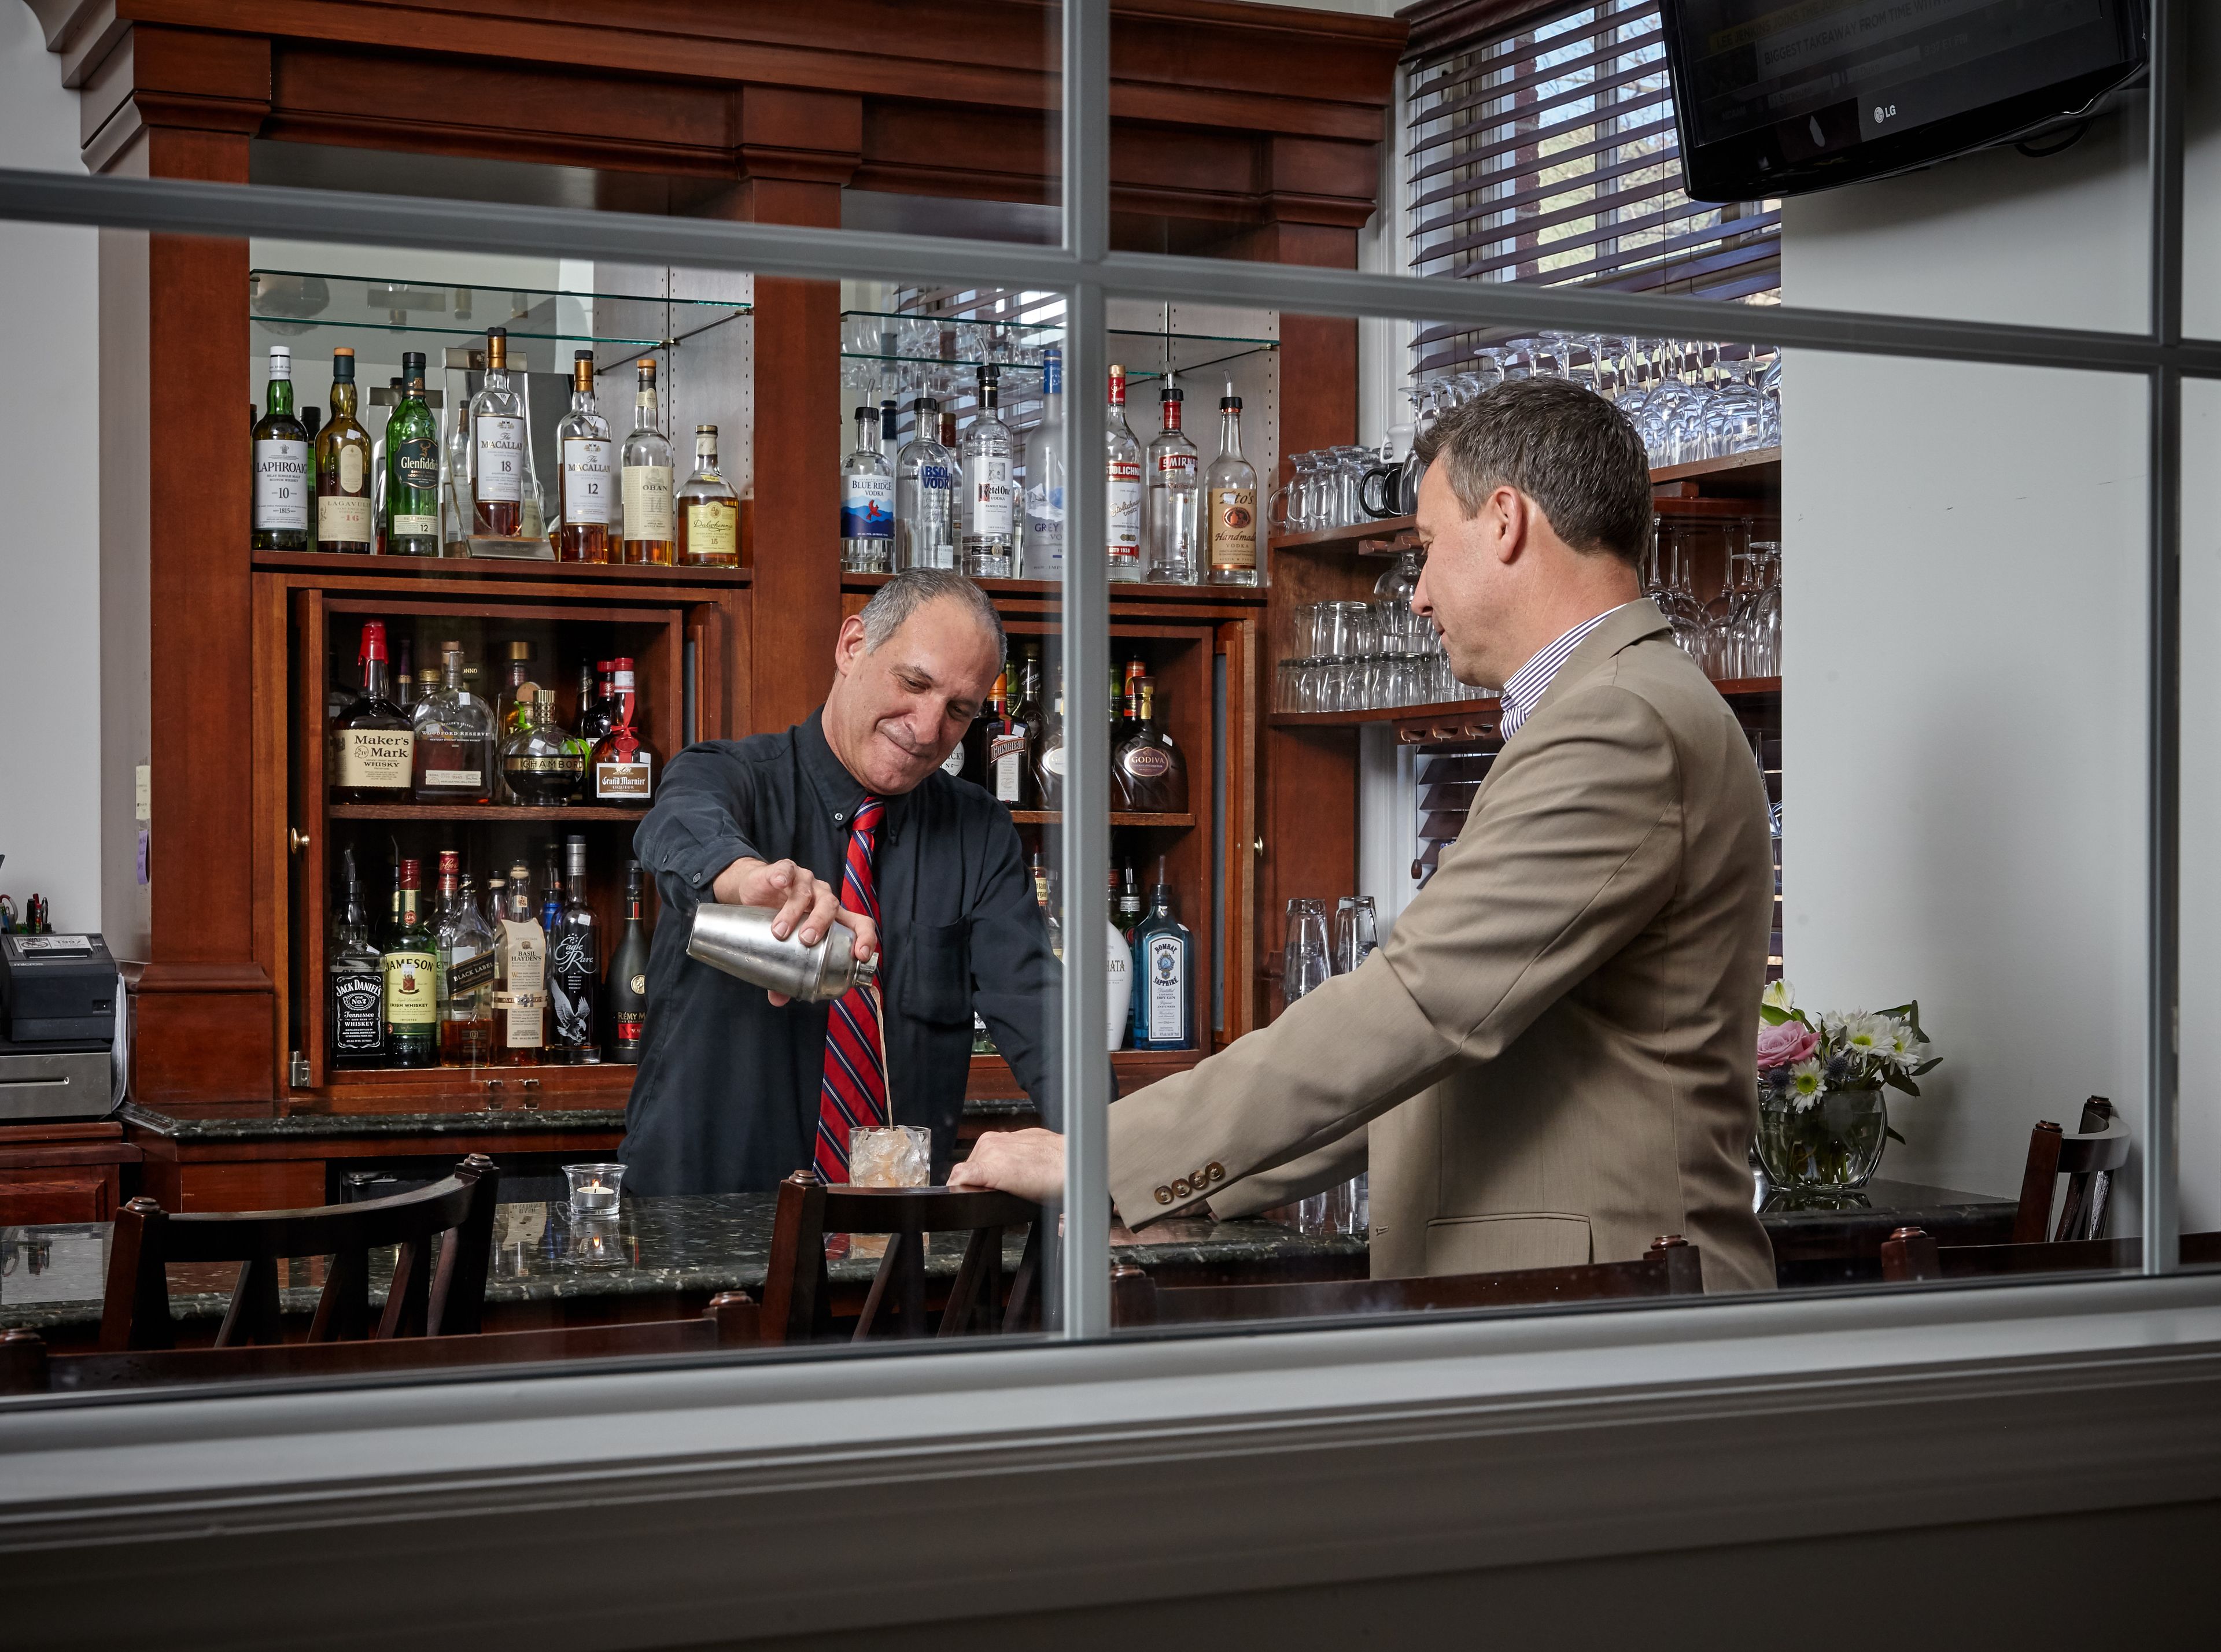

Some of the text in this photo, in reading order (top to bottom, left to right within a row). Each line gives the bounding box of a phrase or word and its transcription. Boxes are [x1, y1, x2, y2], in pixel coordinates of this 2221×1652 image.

[1734, 20, 1770, 44] JENKINS
[1764, 39, 1803, 65] BIGGEST
[1803, 21, 1857, 51] TAKEAWAY
[1858, 11, 1887, 32] FROM
[1887, 2, 1912, 22] TIME
[1884, 104, 1897, 118] LG
[499, 432, 511, 440] The
[586, 455, 597, 463] The
[501, 461, 511, 472] 18
[568, 464, 611, 472] MACALLAN
[588, 483, 598, 494] 12
[853, 481, 892, 490] BLUE RIDGE
[923, 478, 950, 490] VODK
[279, 487, 289, 498] 10
[1001, 486, 1010, 496] One
[1035, 523, 1058, 532] GREY
[354, 735, 409, 745] Maker's
[370, 747, 408, 757] Mark
[992, 740, 1024, 759] COINTREAU
[523, 759, 583, 768] CHAMBORD
[602, 776, 645, 785] Grand Marnier
[555, 933, 588, 964] Eagle
[1154, 944, 1178, 954] BOMBAY
[385, 959, 433, 972] JAMESON
[453, 970, 474, 982] BLACK
[475, 962, 493, 973] LABEL
[1153, 976, 1179, 986] SAPPHIRE
[336, 979, 382, 997] JACK DANIEL'S
